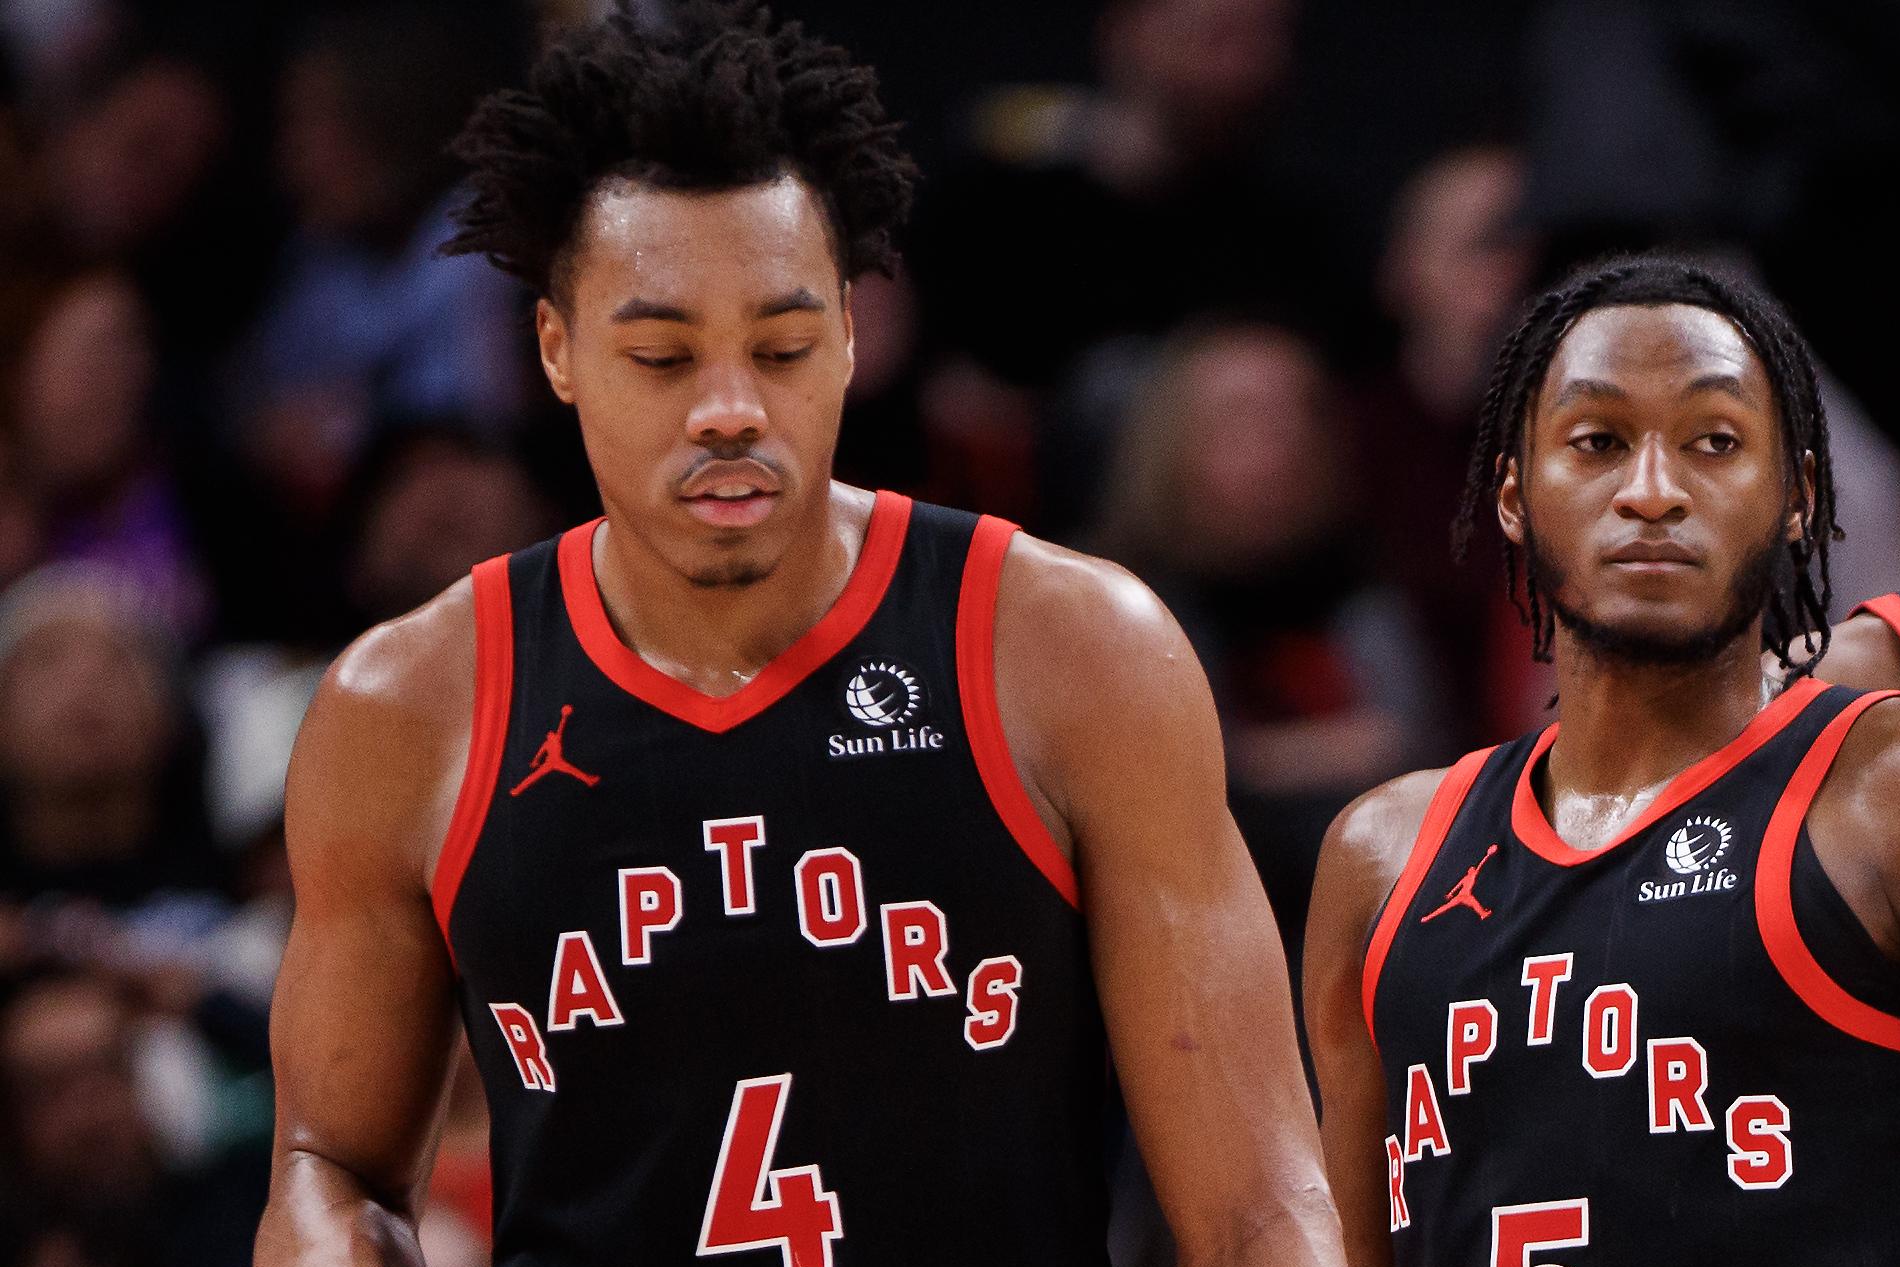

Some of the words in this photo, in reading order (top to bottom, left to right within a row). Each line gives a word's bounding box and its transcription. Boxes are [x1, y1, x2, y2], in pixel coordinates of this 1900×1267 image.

[828, 733, 884, 757] Sun
[891, 725, 944, 751] Life
[488, 815, 1023, 1093] RAPTORS
[1638, 881, 1686, 902] Sun
[1690, 868, 1738, 894] Life
[1384, 952, 1793, 1233] RAPTORS
